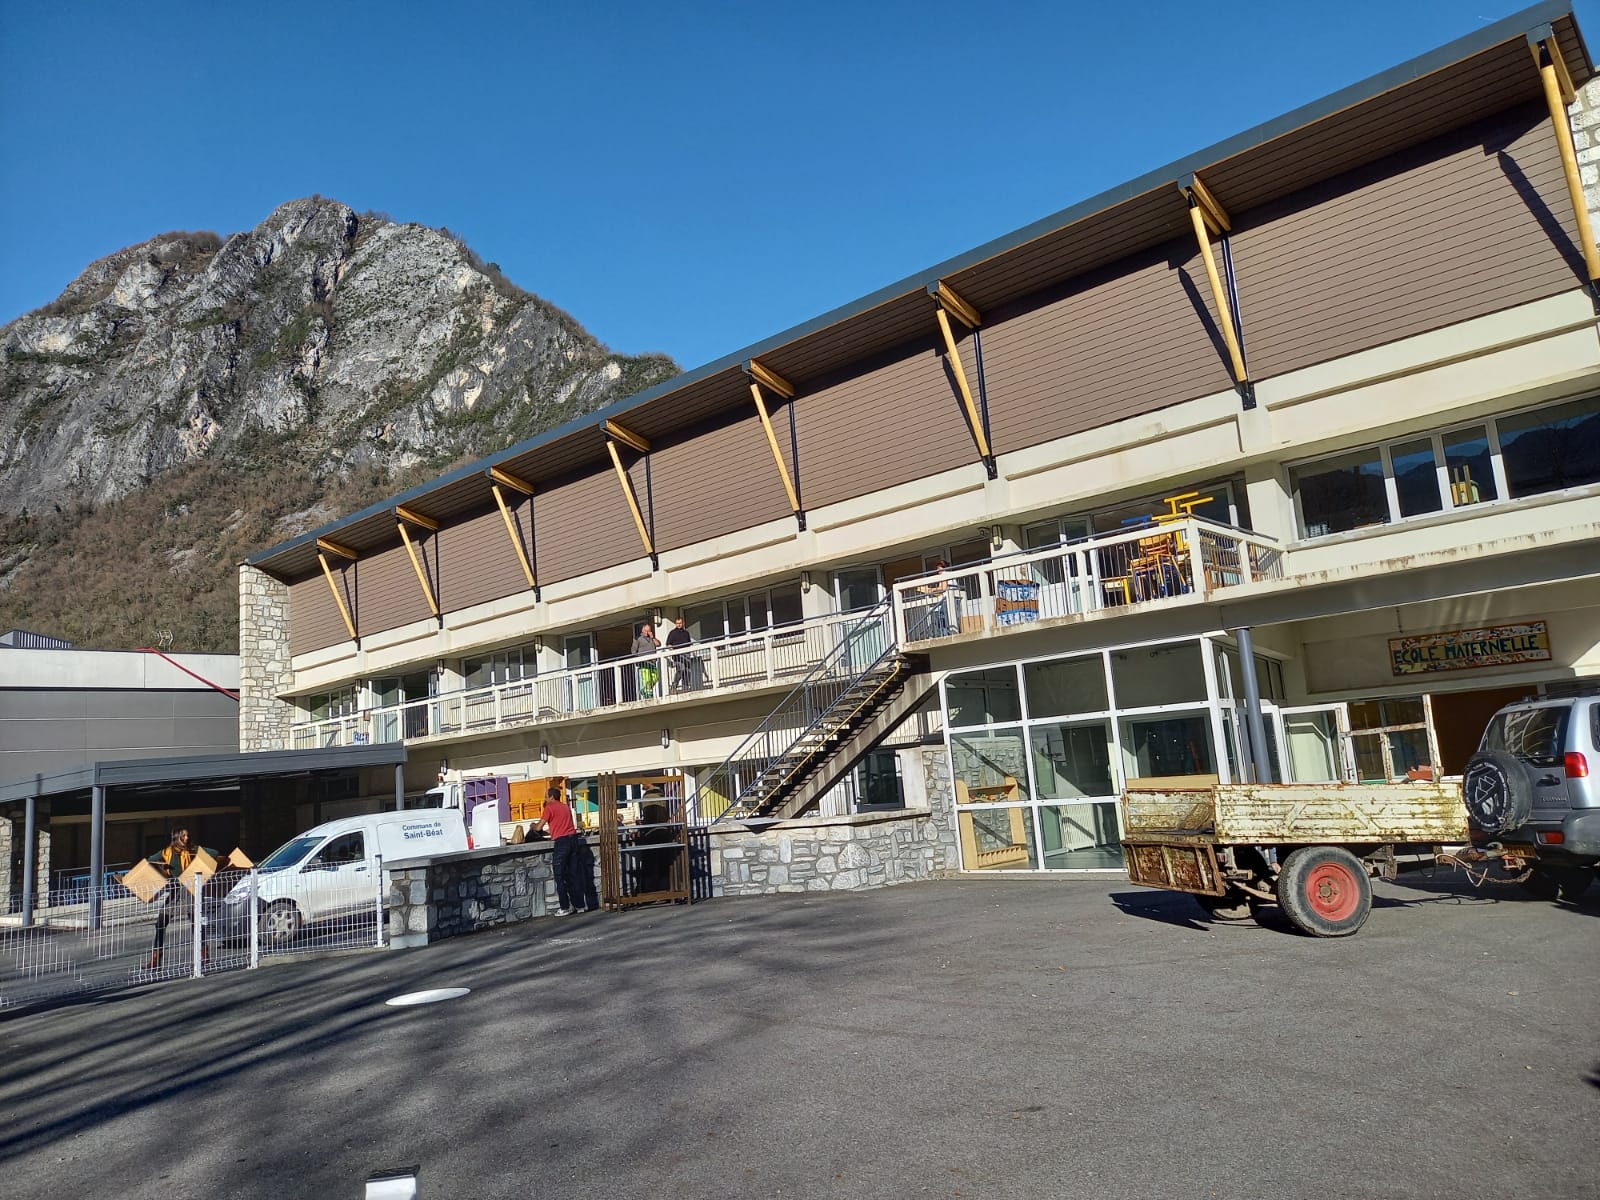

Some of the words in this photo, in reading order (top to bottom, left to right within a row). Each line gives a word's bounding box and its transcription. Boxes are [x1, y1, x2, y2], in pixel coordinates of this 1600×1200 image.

[1393, 646, 1440, 664] ECOLE
[1445, 635, 1539, 659] MATERNELLE
[402, 823, 432, 831] Commune
[403, 828, 443, 839] Saint-Béat
